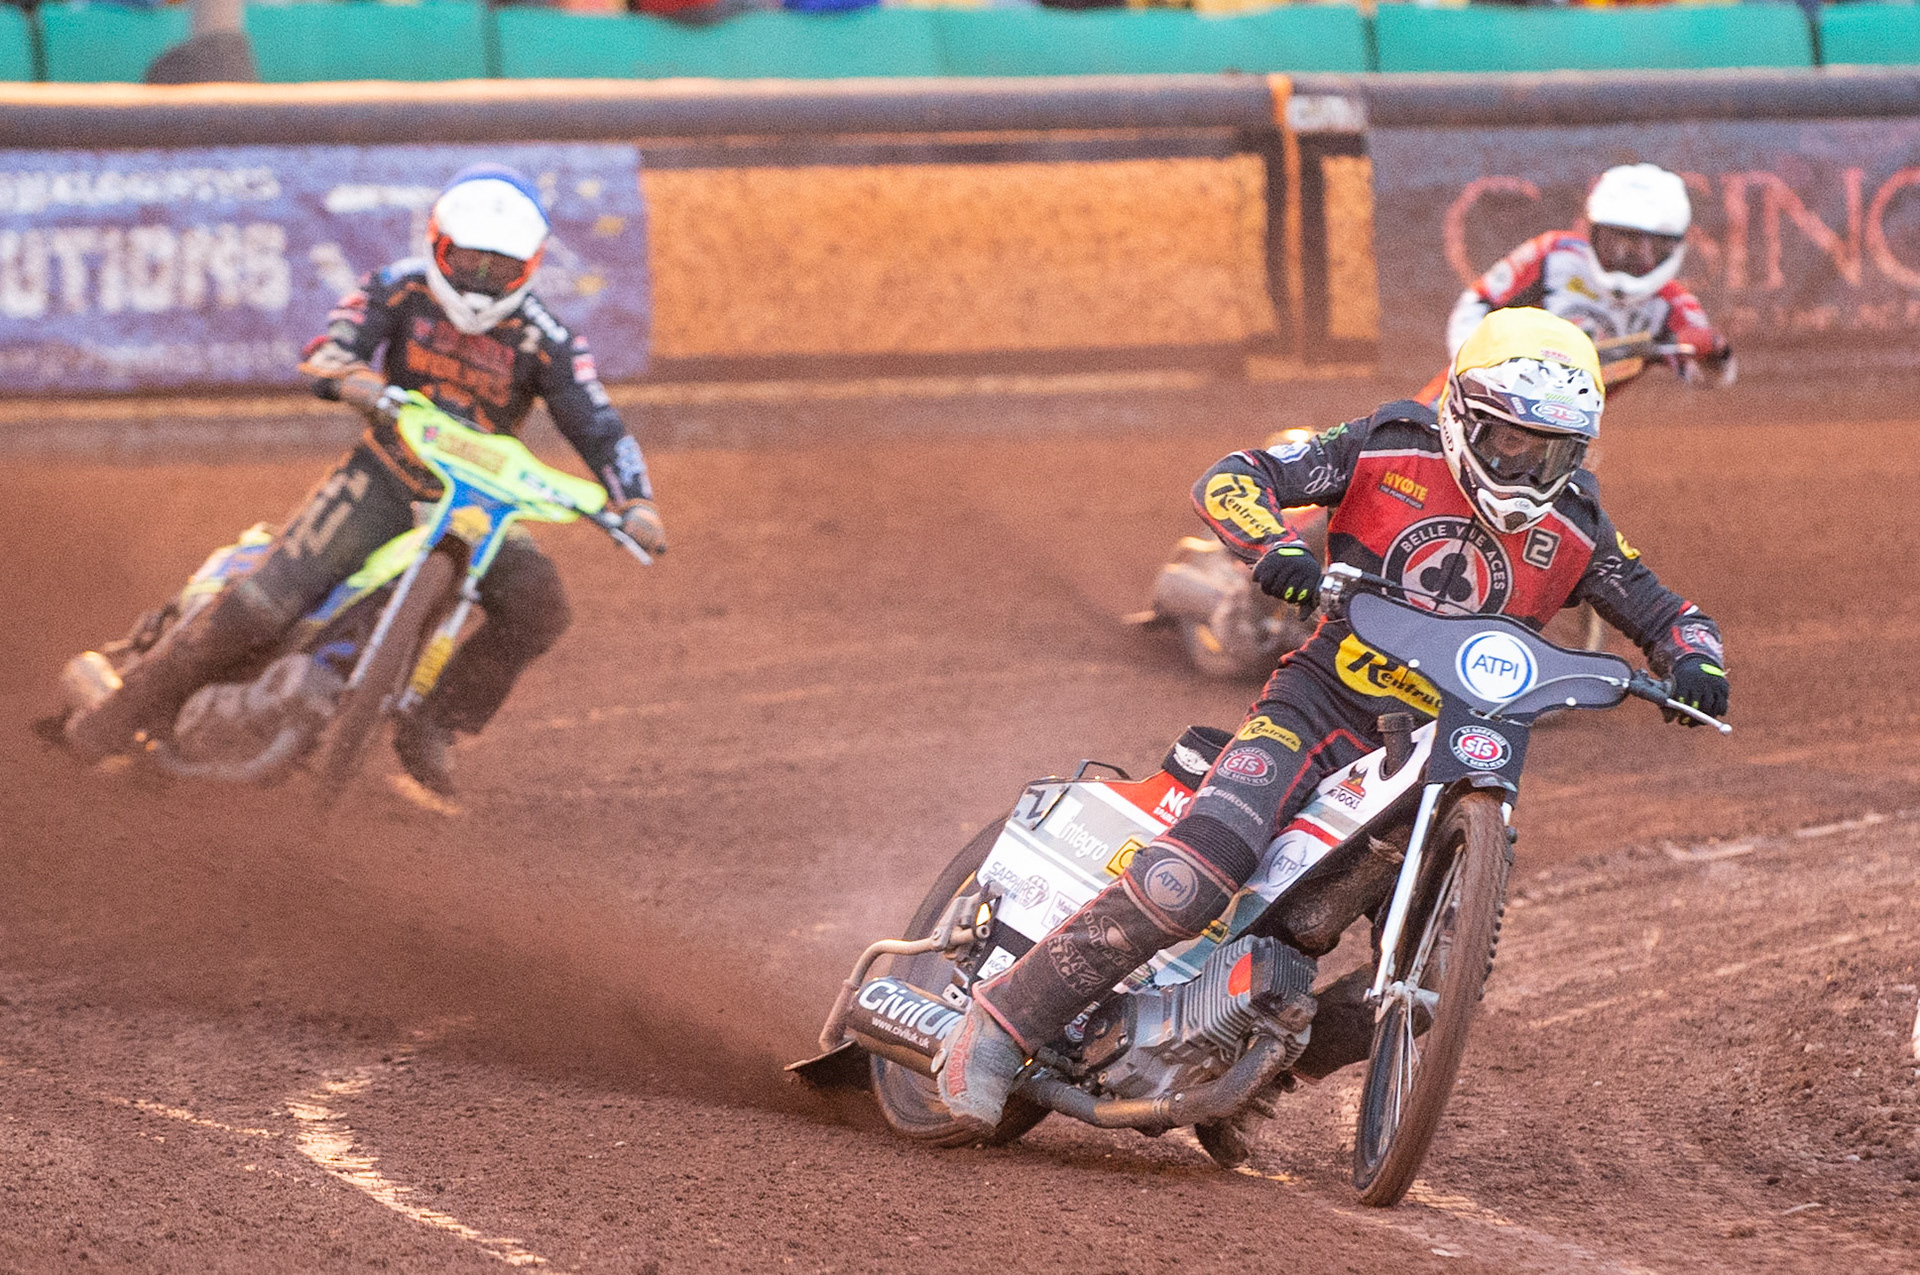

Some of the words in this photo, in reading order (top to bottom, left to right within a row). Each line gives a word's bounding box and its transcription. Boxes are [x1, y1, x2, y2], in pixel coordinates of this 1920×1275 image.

[1400, 524, 1447, 553] BELLE
[1486, 551, 1506, 590] ACES
[1529, 532, 1554, 563] 2
[1346, 651, 1444, 709] Rentruc
[1464, 736, 1495, 758] STS
[1228, 753, 1259, 774] STS
